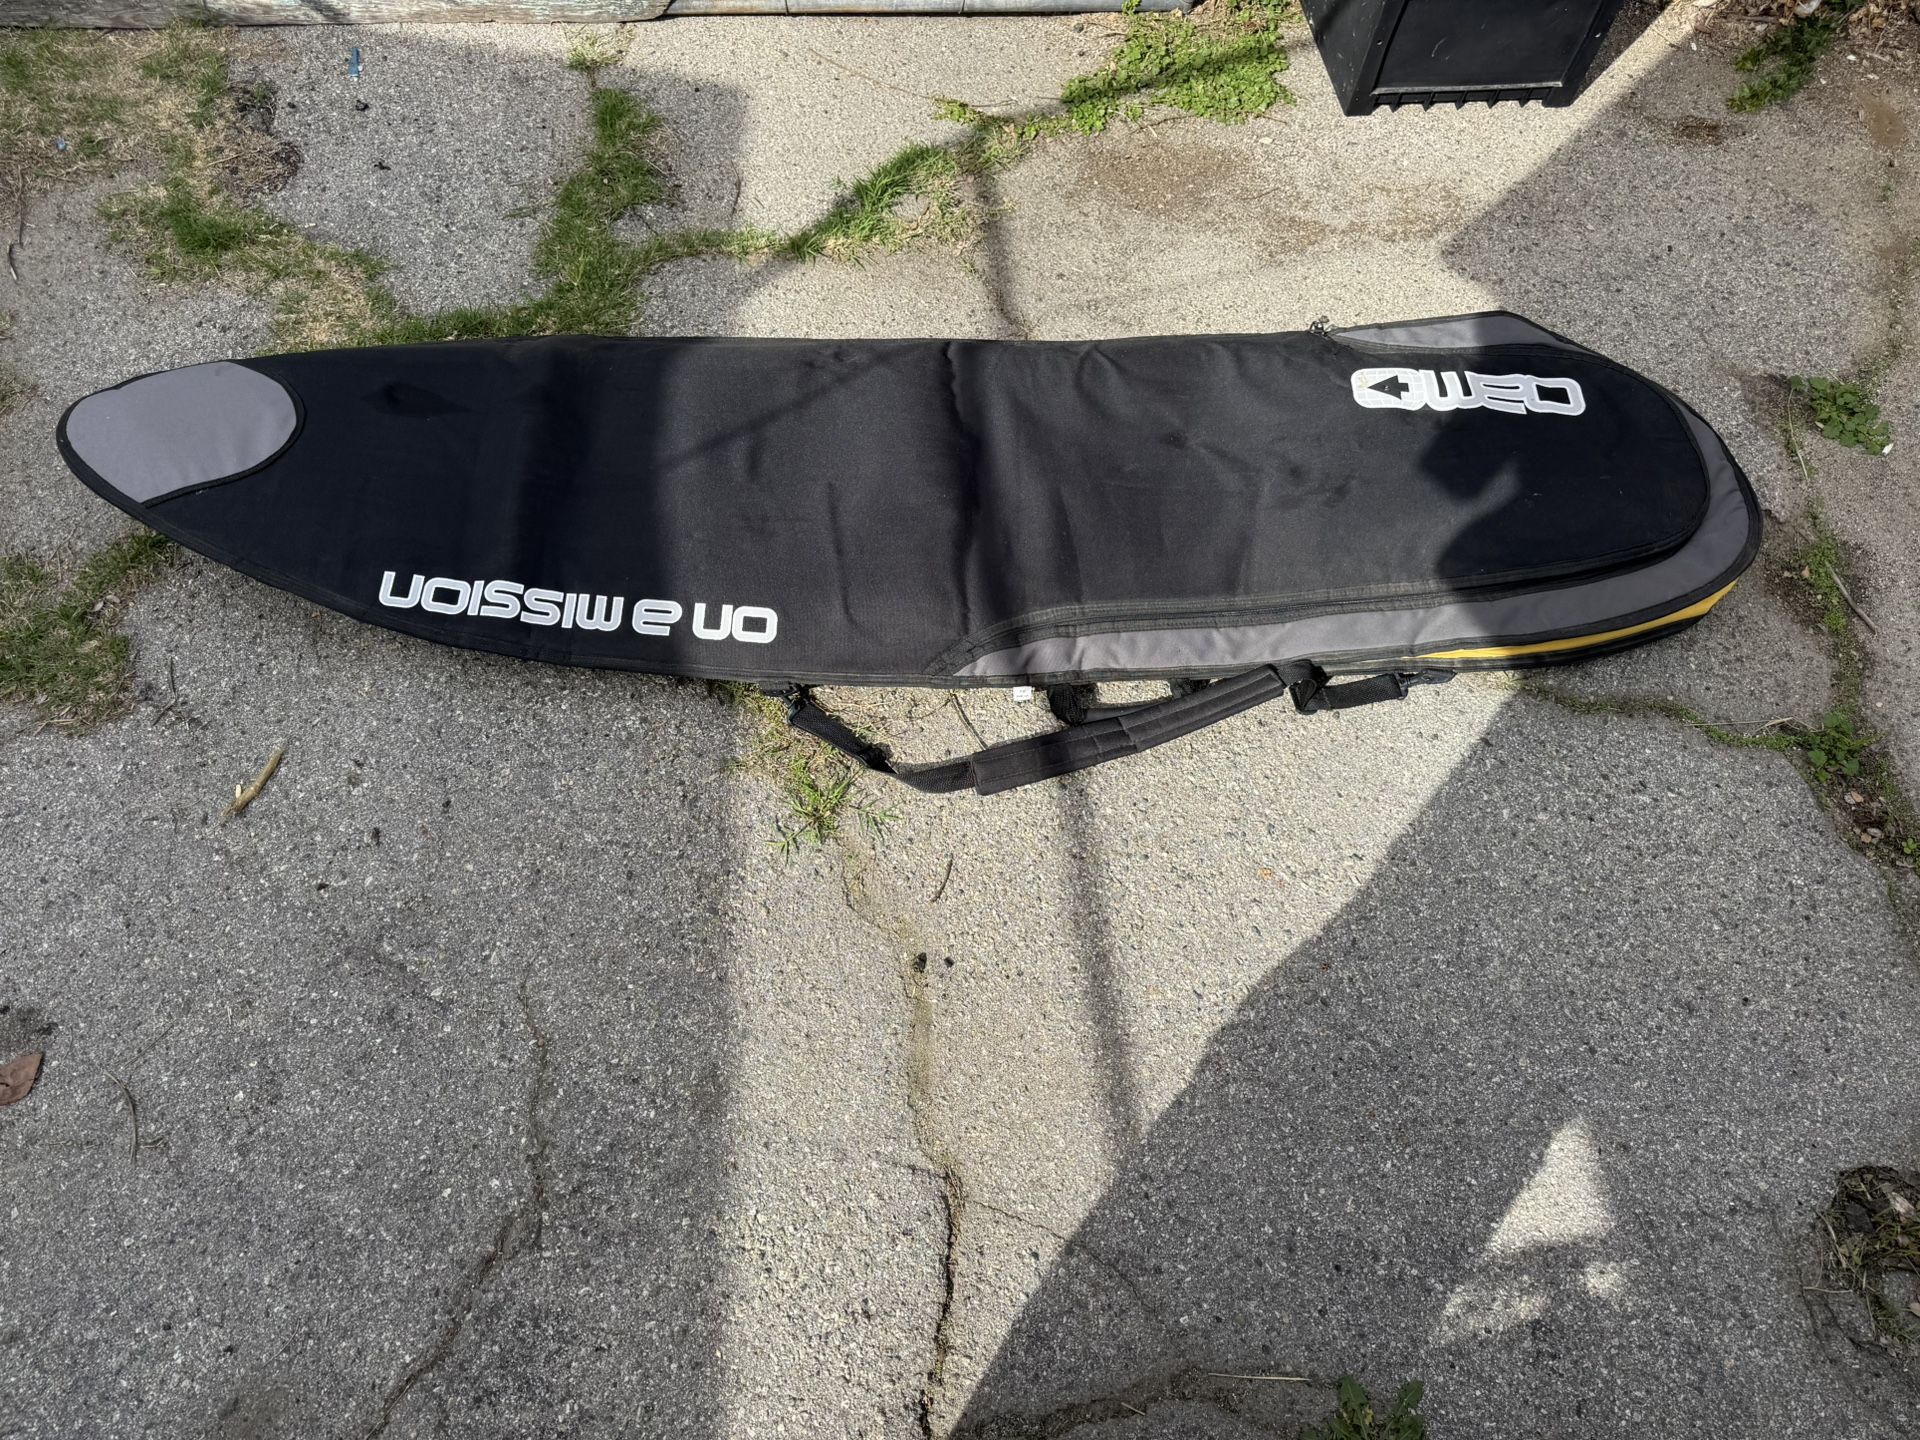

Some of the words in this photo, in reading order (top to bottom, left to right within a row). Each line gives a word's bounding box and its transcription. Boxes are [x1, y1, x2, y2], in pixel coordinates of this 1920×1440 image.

[377, 570, 625, 632] mission
[631, 598, 684, 637] a
[691, 602, 779, 644] on
